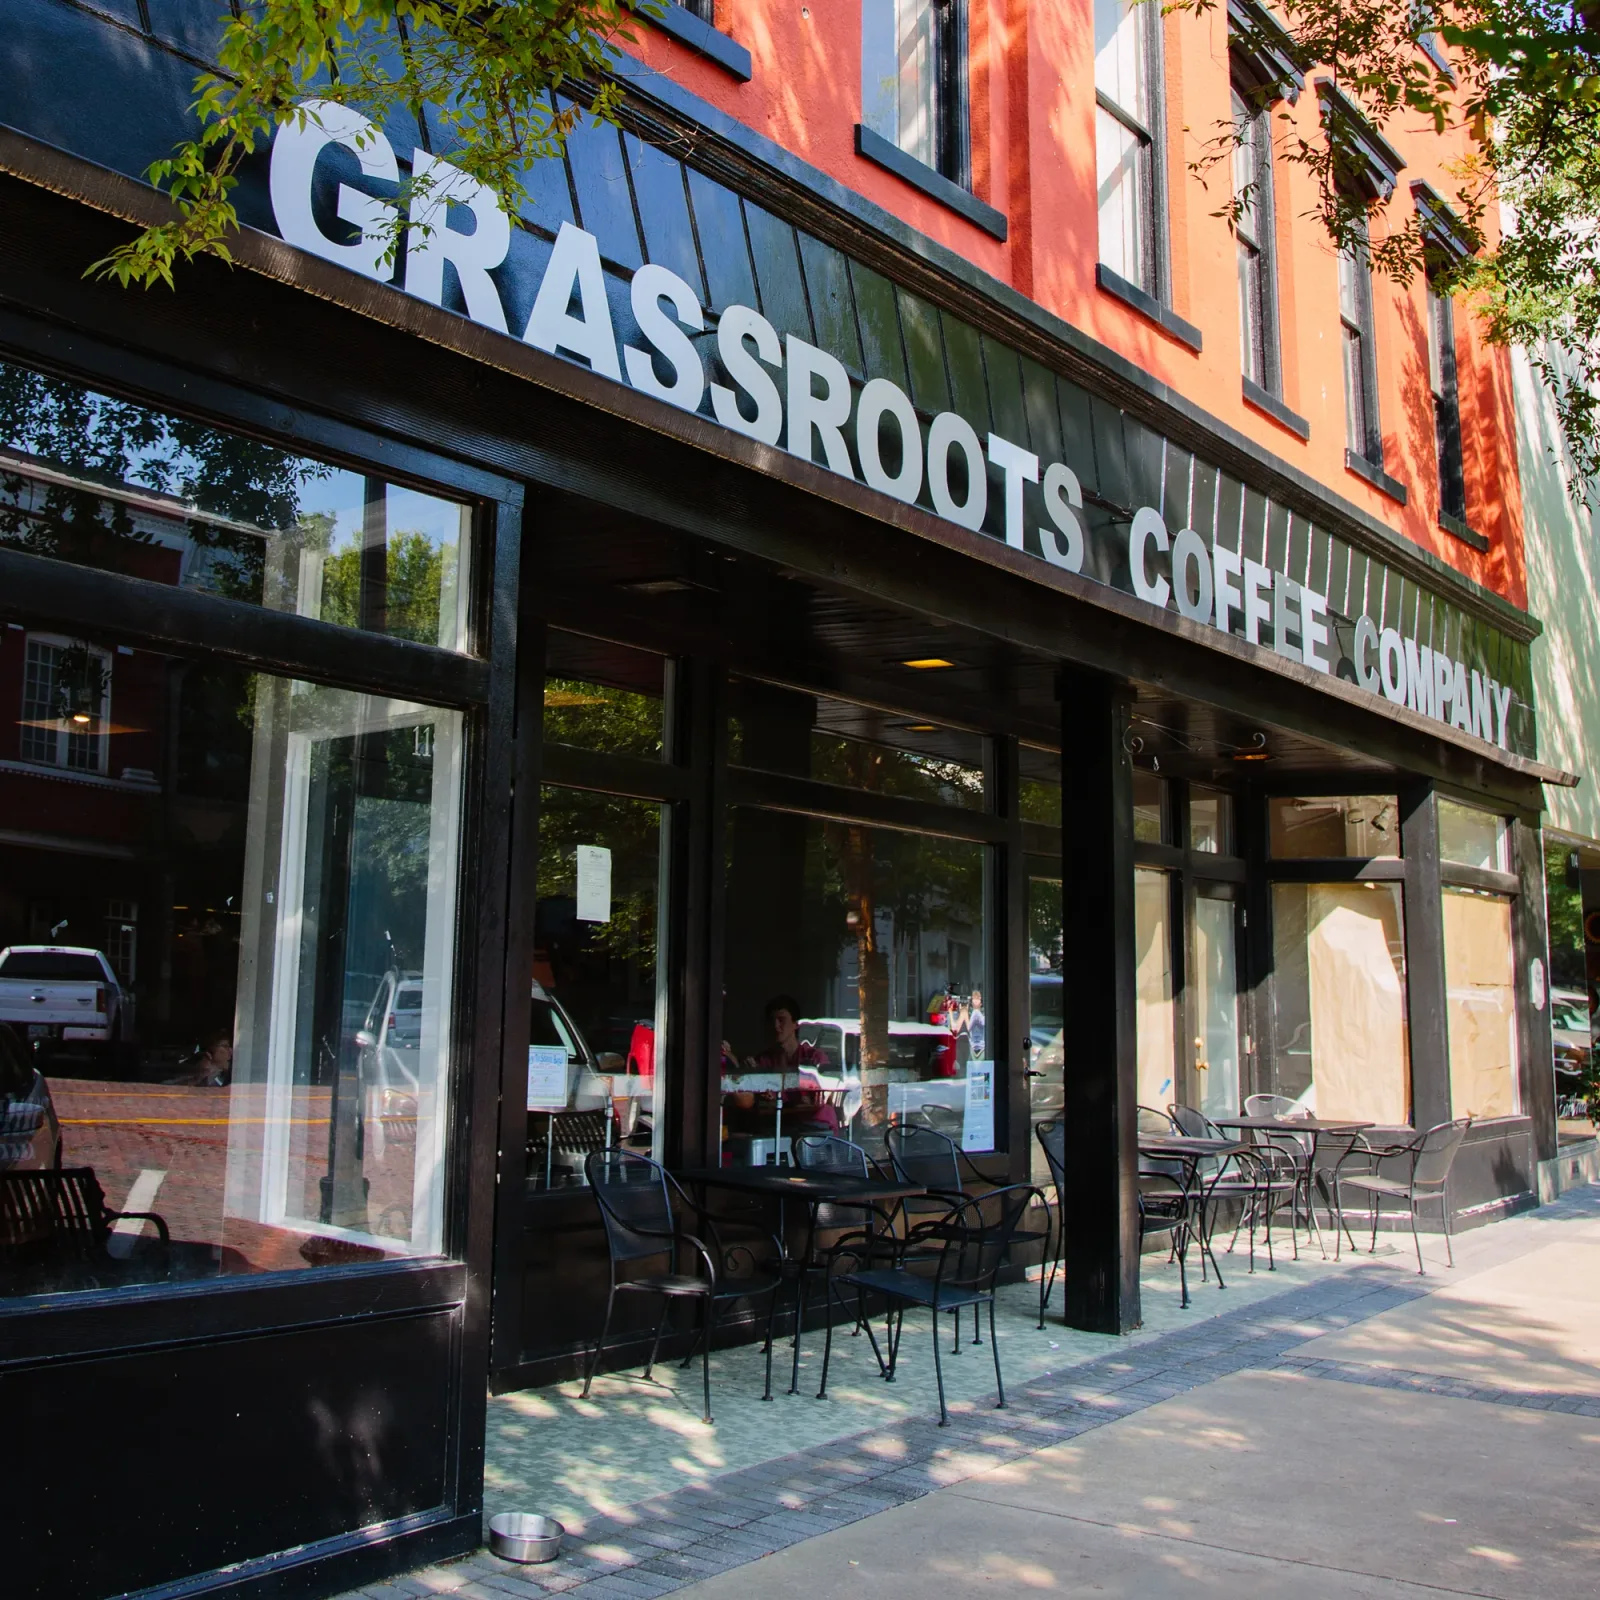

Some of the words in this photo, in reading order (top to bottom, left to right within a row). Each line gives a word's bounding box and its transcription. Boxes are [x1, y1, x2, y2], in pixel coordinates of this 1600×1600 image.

[270, 100, 1084, 574] GRASSROOTS
[1129, 507, 1329, 674] COFFEE
[1354, 615, 1511, 750] COMPANY
[412, 725, 437, 757] 11
